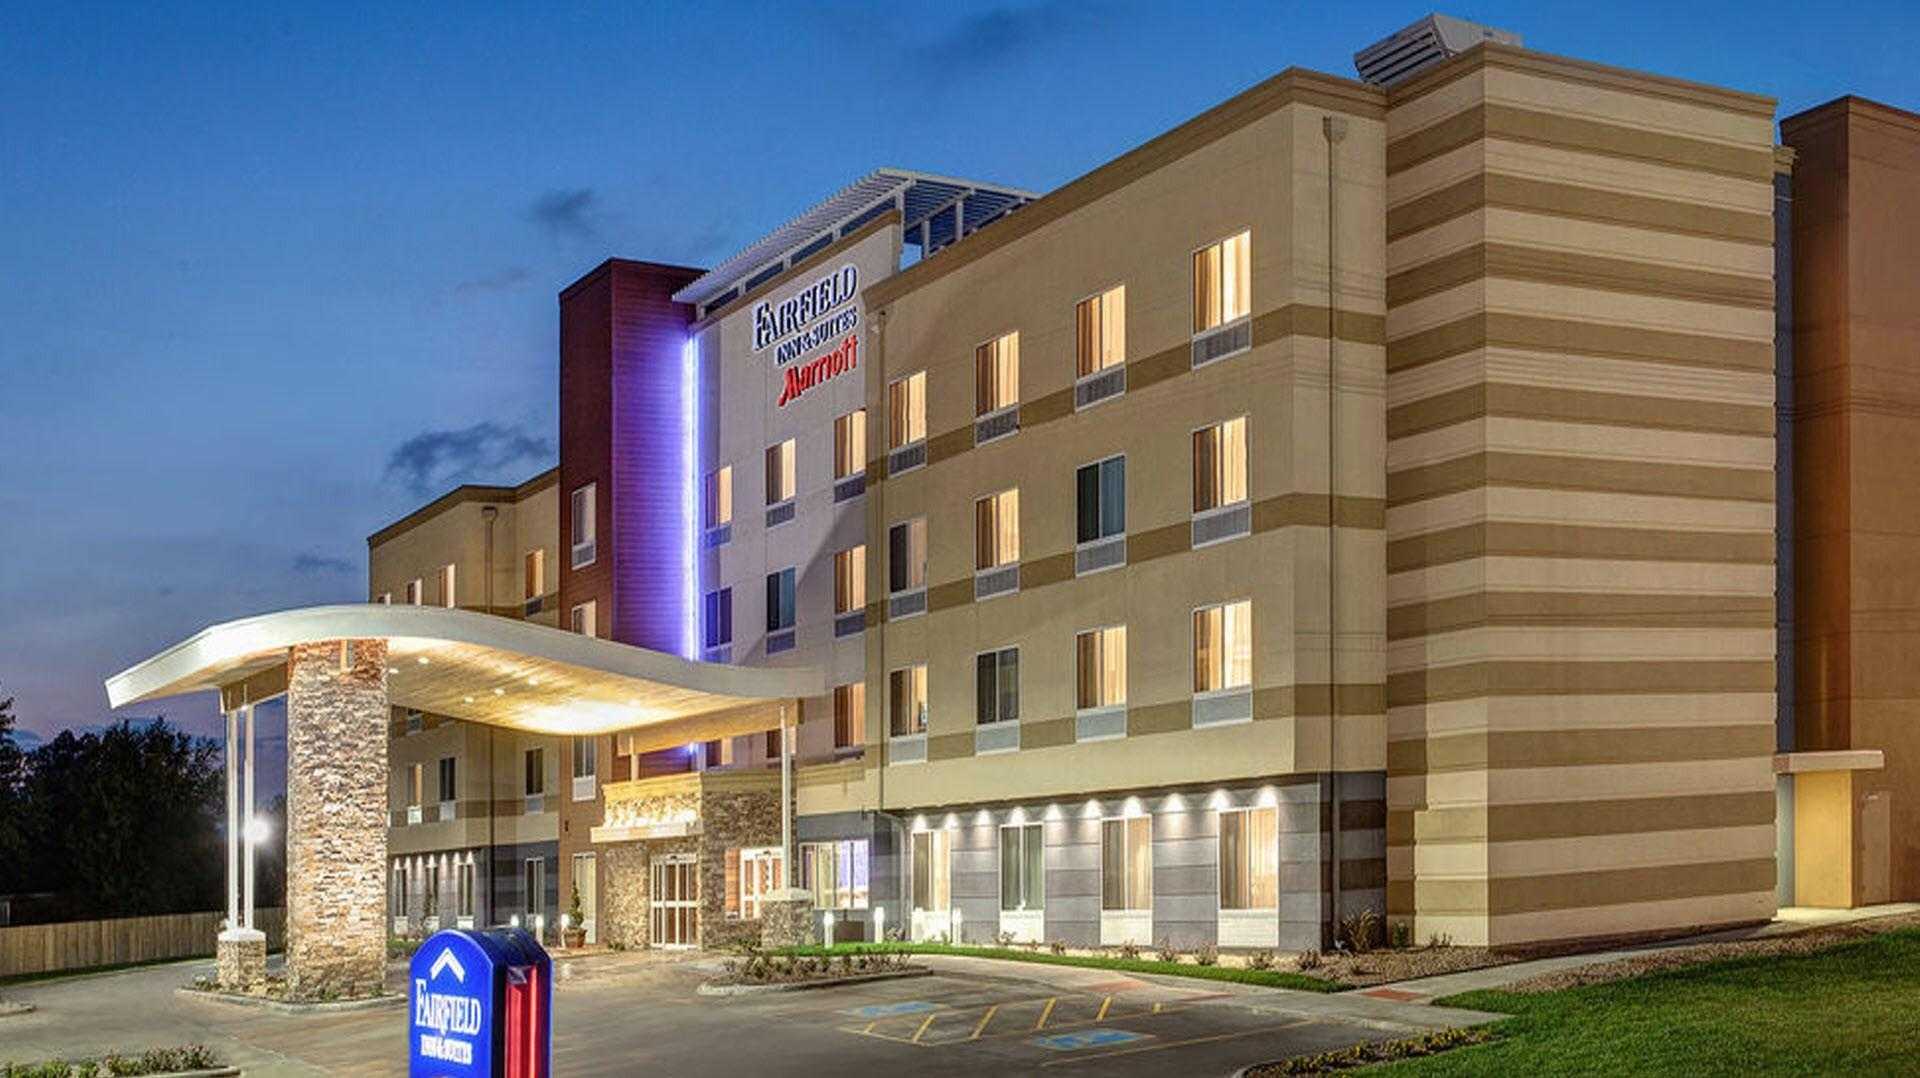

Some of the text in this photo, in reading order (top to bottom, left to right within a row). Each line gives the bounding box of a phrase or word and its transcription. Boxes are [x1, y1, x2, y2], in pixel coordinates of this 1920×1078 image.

[753, 264, 858, 350] FAIRFIELD
[778, 335, 858, 407] Marriott
[416, 979, 481, 1035] FAIRFIELD
